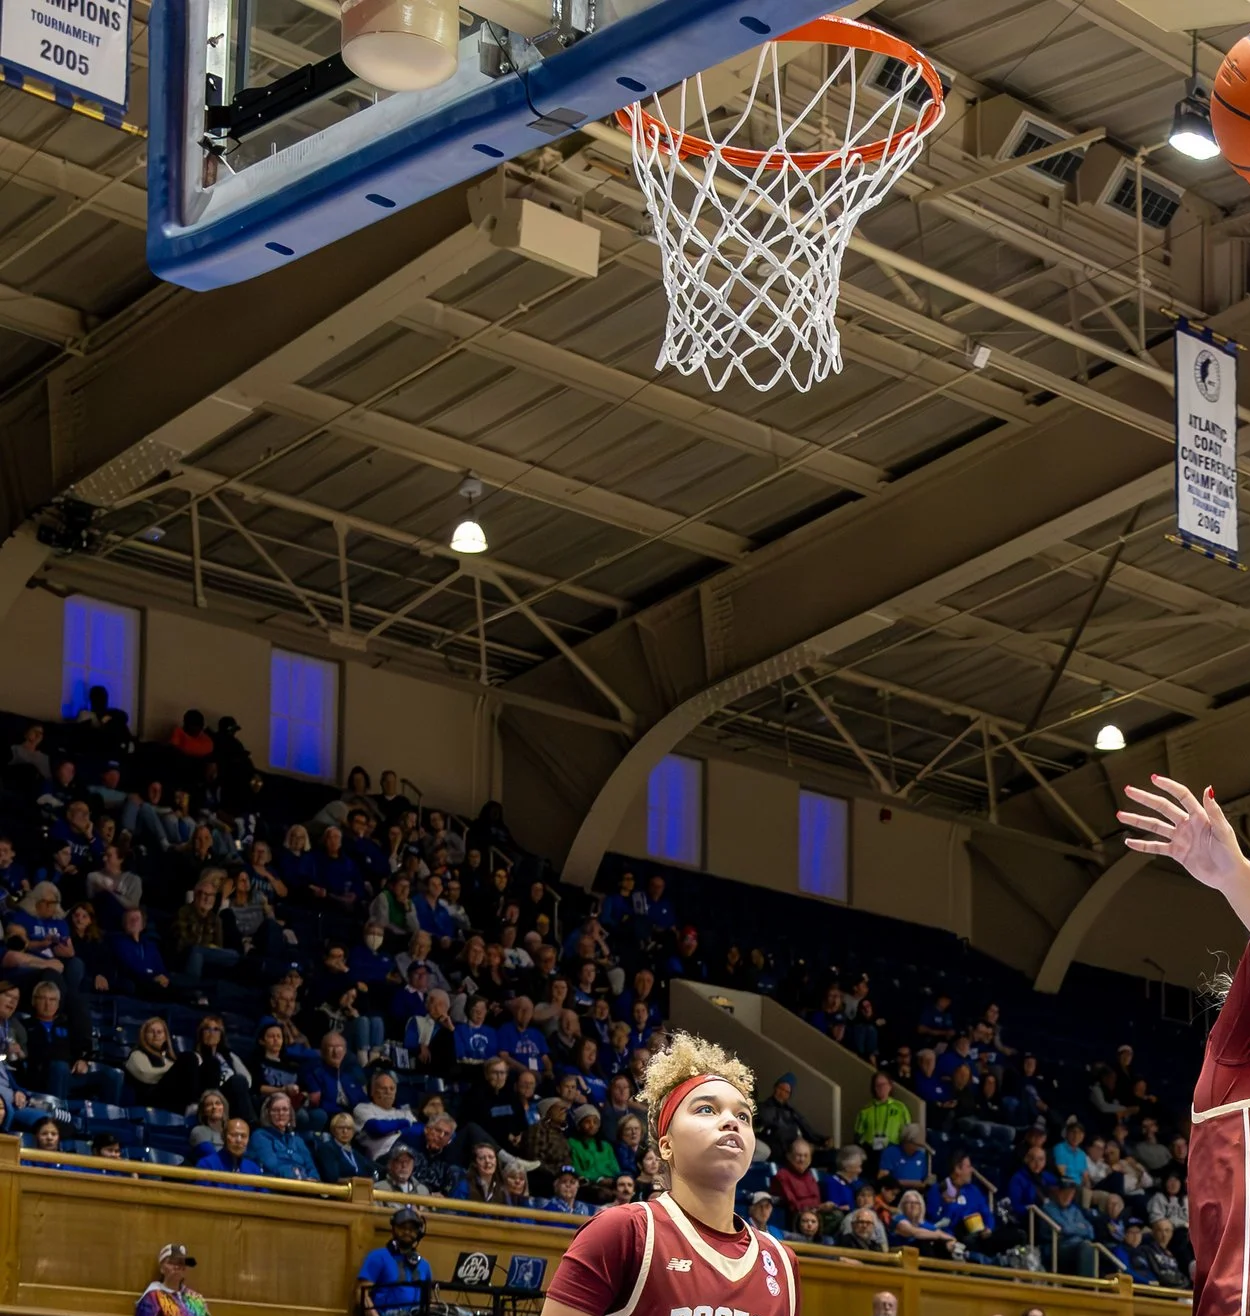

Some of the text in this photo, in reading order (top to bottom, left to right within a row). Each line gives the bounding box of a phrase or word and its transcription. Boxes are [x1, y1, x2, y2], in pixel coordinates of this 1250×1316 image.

[31, 9, 101, 47] TOURNAMENT
[40, 39, 89, 76] 2005
[1189, 414, 1227, 443] ATLANTIC
[1194, 434, 1222, 457] COAST
[1181, 446, 1236, 483] CONFERENCE
[1184, 466, 1234, 499] CHAMPIONS
[1197, 512, 1220, 535] 2006
